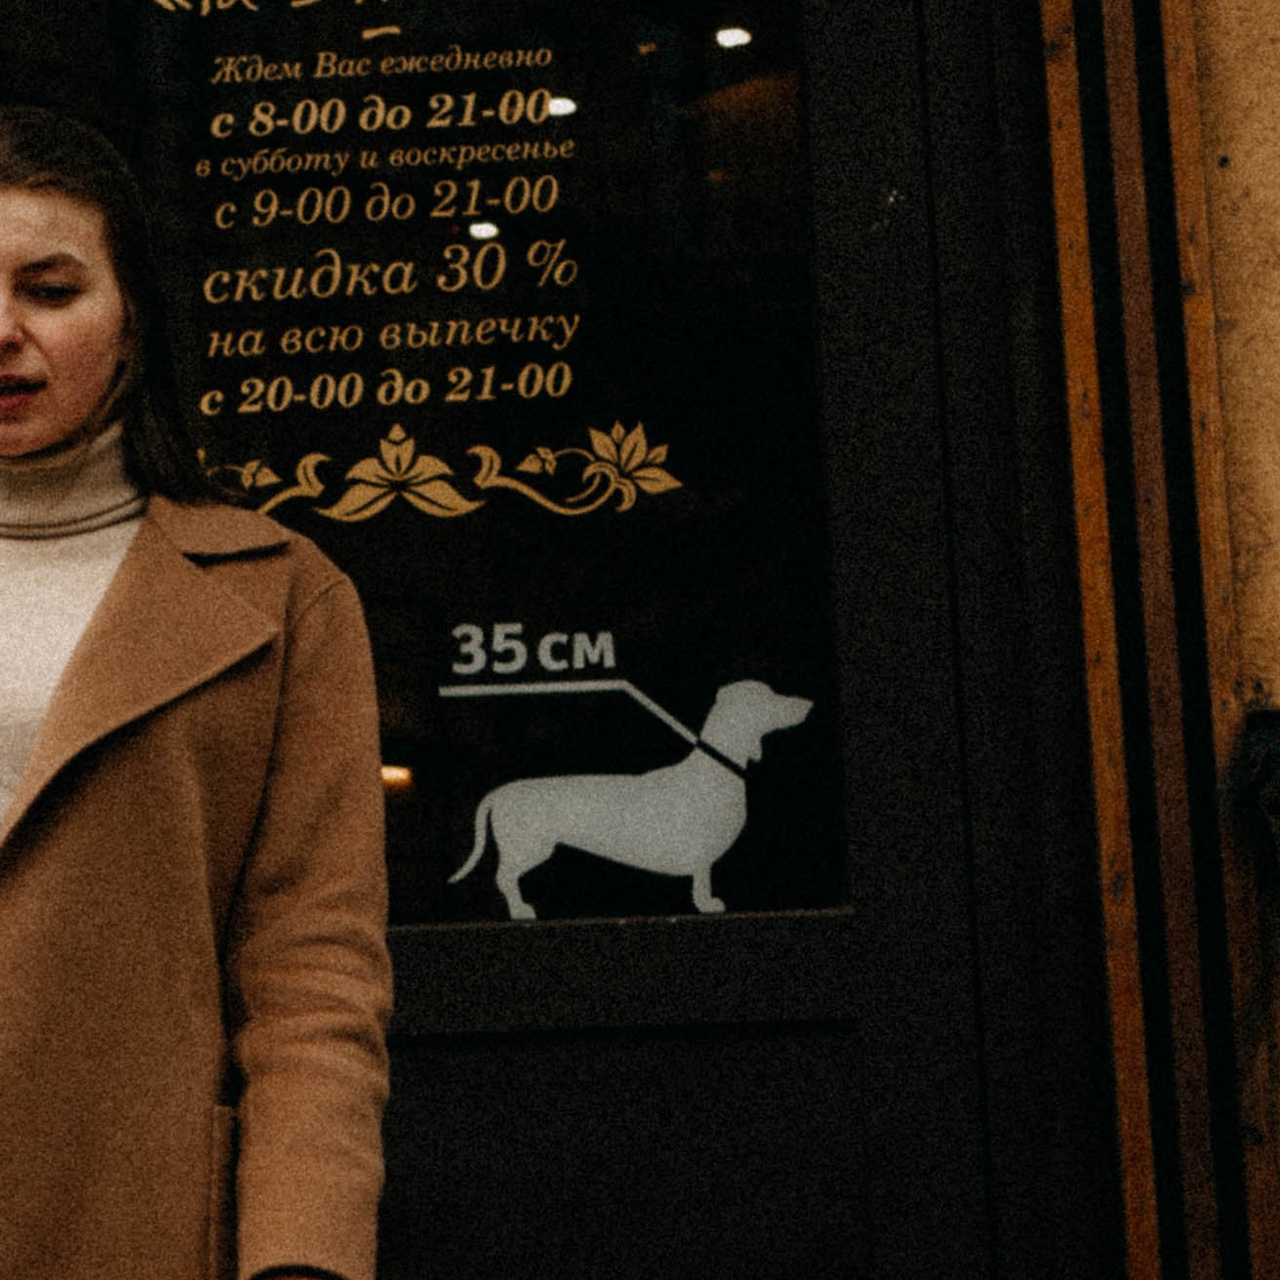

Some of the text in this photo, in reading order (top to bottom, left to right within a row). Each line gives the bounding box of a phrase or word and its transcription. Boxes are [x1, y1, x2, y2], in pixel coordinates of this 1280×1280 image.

[211, 46, 553, 84] Ждем Вас ежедневно
[210, 88, 552, 138] с 8-00 до 21-00
[195, 139, 576, 181] в субботу и воскресенье
[215, 175, 559, 228] с 9-00 до 21-00
[203, 248, 417, 304] скидка
[436, 242, 507, 292] 30
[208, 314, 581, 358] на всю выпечку
[199, 362, 572, 416] с 20-00 до 21-00
